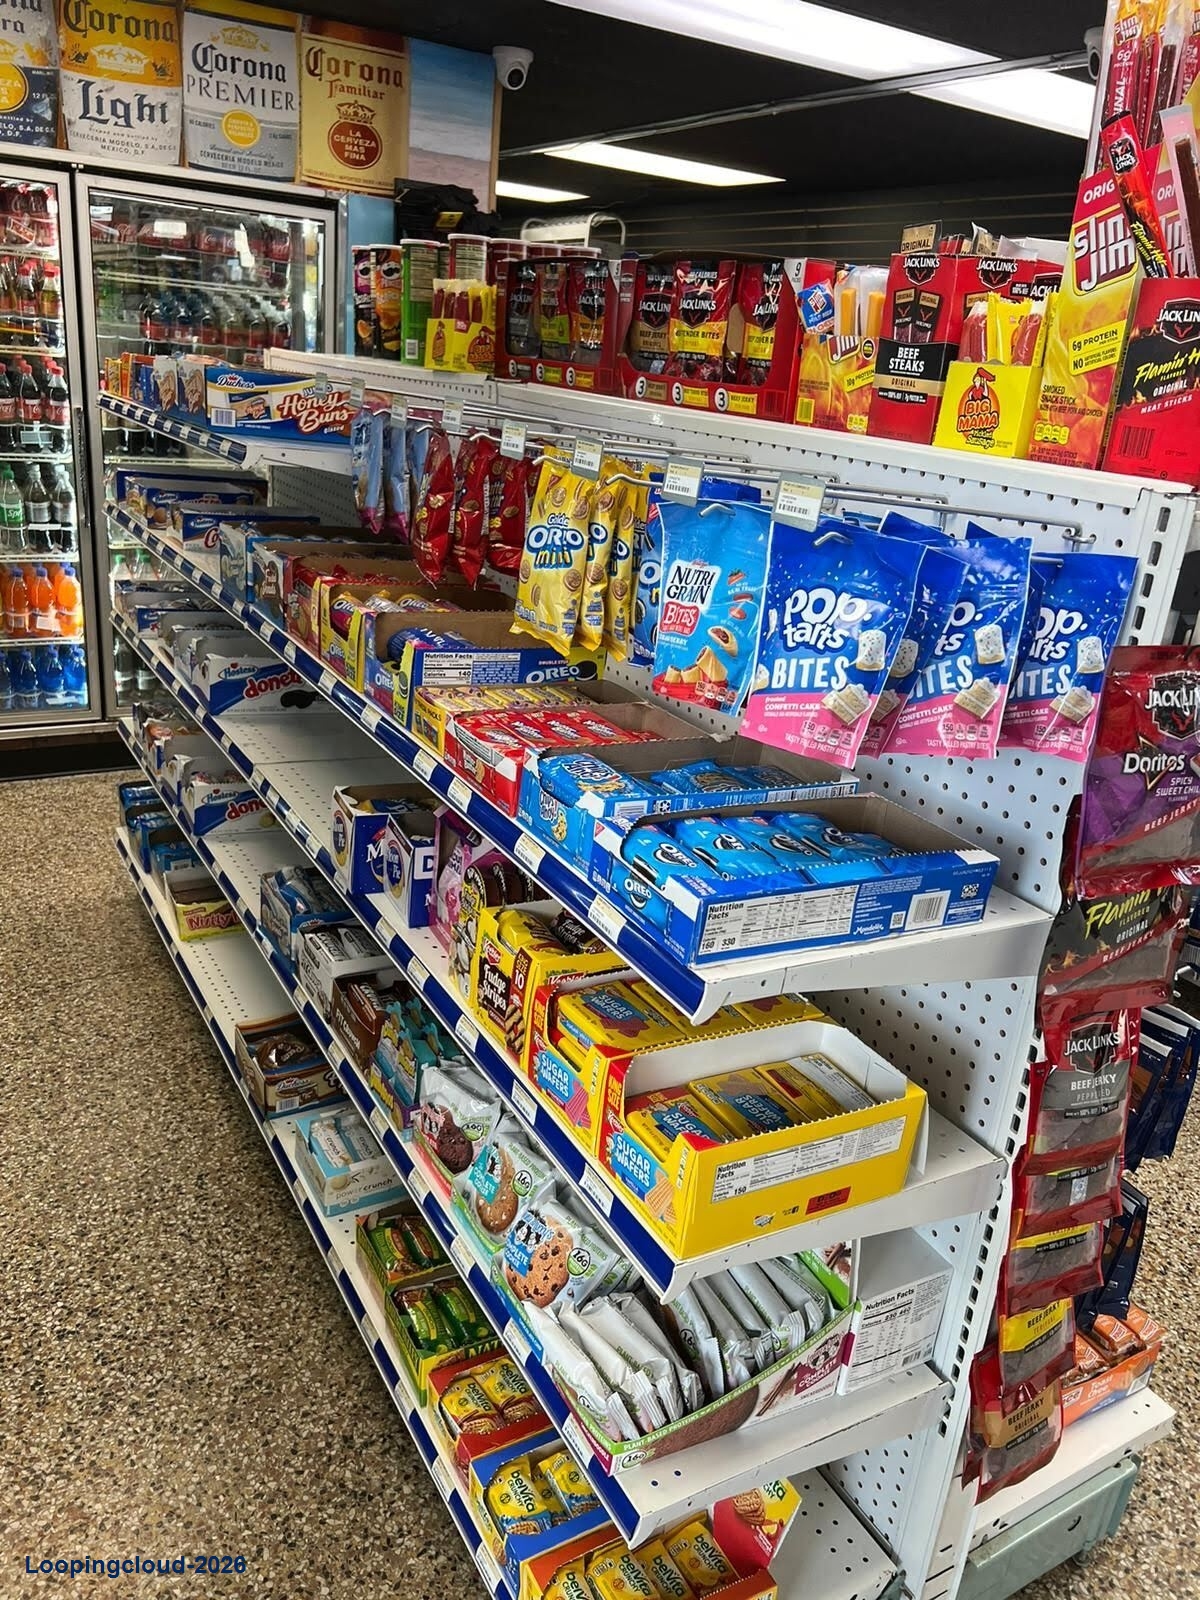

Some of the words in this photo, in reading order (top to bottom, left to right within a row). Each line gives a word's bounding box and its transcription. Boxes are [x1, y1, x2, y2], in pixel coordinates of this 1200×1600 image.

[63, 0, 175, 43] Corona
[191, 42, 287, 83] Corona
[1116, 50, 1132, 61] 6g
[305, 46, 404, 88] Corona
[186, 73, 296, 111] PREMIER
[327, 78, 386, 100] Familiar
[77, 79, 170, 129] Light
[334, 134, 377, 149] CERVEZA
[344, 152, 367, 161] FINA
[1115, 153, 1133, 164] JACK
[1083, 179, 1116, 204] ORIG
[901, 239, 931, 252] ORIGINAL
[794, 261, 801, 277] 9
[903, 257, 920, 269] JACK
[976, 259, 995, 271] JACK
[1080, 237, 1137, 291] Jim
[638, 300, 656, 312] JACK
[679, 298, 695, 310] JACK
[1156, 308, 1183, 323] JACK
[1183, 308, 1200, 323] LIN
[701, 331, 720, 339] BITES
[1072, 340, 1082, 351] 6g
[1083, 328, 1118, 345] PROTEIN
[897, 347, 920, 359] BEEF
[509, 363, 517, 375] 3
[537, 367, 544, 379] 3
[888, 358, 925, 373] STEAKS
[1073, 357, 1084, 370] NO
[1133, 351, 1189, 387] Flamin'
[217, 374, 257, 389] Duchess
[568, 370, 575, 384] 3
[891, 378, 916, 388] ORIGINAL
[1160, 369, 1186, 382] FLAVORED
[638, 380, 645, 394] 3
[675, 386, 681, 401] 3
[1042, 385, 1066, 394] SMOKED
[1153, 378, 1188, 398] ORIGINAL
[279, 392, 340, 416] Honey
[718, 392, 725, 407] 3
[966, 400, 991, 415] BIG
[1041, 394, 1061, 404] SNACK
[1061, 395, 1077, 405] STICK
[1140, 400, 1162, 415] MEAT
[1163, 393, 1194, 408] STICKS
[296, 408, 354, 433] Buns
[958, 413, 998, 431] MAMA
[671, 565, 716, 585] NUTRI
[667, 584, 712, 605] GRAIN
[663, 604, 696, 627] BITES
[783, 622, 850, 650] tarts
[424, 652, 454, 660] Nutrition
[220, 665, 258, 678] Hostess
[525, 665, 580, 684] OREO
[771, 655, 850, 691] BITES
[764, 703, 799, 711] CONFETTI
[799, 703, 820, 711] CAKE
[1145, 688, 1180, 710] JACK
[898, 708, 932, 724] CONFETTI
[931, 704, 954, 715] CAKE
[1030, 707, 1049, 716] CAKE
[803, 720, 816, 731] 150
[943, 723, 954, 731] 150
[785, 732, 800, 745] TASTY
[817, 744, 835, 754] PASTRY
[834, 747, 851, 757] BITES
[1123, 753, 1186, 774] Doritos
[1170, 776, 1194, 786] SPICY
[206, 791, 238, 803] Hostess
[1155, 786, 1182, 797] SWEET
[1183, 785, 1200, 795] CHIL
[1144, 815, 1168, 832] BEEF
[1169, 798, 1198, 822] JERKY
[659, 843, 698, 869] OREO
[623, 878, 652, 899] OREO
[707, 908, 729, 920] Facts
[708, 902, 744, 914] Nutrition
[1119, 905, 1150, 928] FLAVORED
[563, 918, 586, 936] Fudge
[1115, 919, 1149, 944] ORIGINAL
[701, 941, 715, 951] 160
[721, 937, 736, 946] 330
[1101, 948, 1127, 964] BEEF
[515, 960, 528, 975] SIZE
[483, 964, 507, 993] Fudge
[514, 969, 525, 990] 10
[482, 979, 507, 1012] Stripes
[598, 992, 634, 1018] SUGAR
[590, 994, 626, 1020] WAFERS
[1064, 1038, 1092, 1056] JACK
[541, 1053, 569, 1086] SUGAR
[539, 1068, 569, 1098] WAFERS
[607, 1074, 622, 1092] KING
[1071, 1078, 1092, 1091] BEEF
[1091, 1073, 1117, 1089] JERKY
[606, 1089, 622, 1110] SIZE
[743, 1094, 782, 1124] WAFERS
[735, 1097, 774, 1126] SUGAR
[326, 1137, 340, 1156] crunch
[615, 1135, 651, 1175] SUGAR
[613, 1149, 650, 1189] WAFERS
[716, 1170, 734, 1180] Facts
[717, 1161, 747, 1173] Nutrition
[517, 1174, 531, 1190] 16G
[734, 1186, 747, 1195] 150
[572, 1250, 588, 1268] 16G
[865, 1295, 896, 1311] Nutrition
[896, 1288, 915, 1300] Facts
[861, 1319, 882, 1329] Calories
[884, 1311, 898, 1321] 230
[1027, 1315, 1043, 1329] BEEF
[501, 1363, 529, 1395] belVita
[798, 1359, 837, 1388] COMPLETE
[467, 1382, 492, 1413] belVita
[623, 1436, 646, 1451] PLANT
[646, 1428, 669, 1444] BASED
[668, 1412, 702, 1436] PROTEINS
[712, 1392, 734, 1410] PLANT
[733, 1382, 752, 1399] BASED
[751, 1363, 782, 1387] PROTEINS
[791, 1341, 812, 1359] PLANT
[1007, 1411, 1026, 1426] BEEF
[1025, 1397, 1045, 1416] JERKY
[1014, 1412, 1040, 1432] ORIGINAL
[507, 1478, 525, 1507] CRUNCHY
[510, 1469, 536, 1514] belVita
[692, 1541, 716, 1571] CRUNCHY
[694, 1532, 727, 1574] belVita
[618, 1561, 641, 1593] CRUNCHY
[620, 1553, 651, 1597] belVita
[650, 1563, 674, 1595] CRUNCHY
[652, 1554, 685, 1597] belVita
